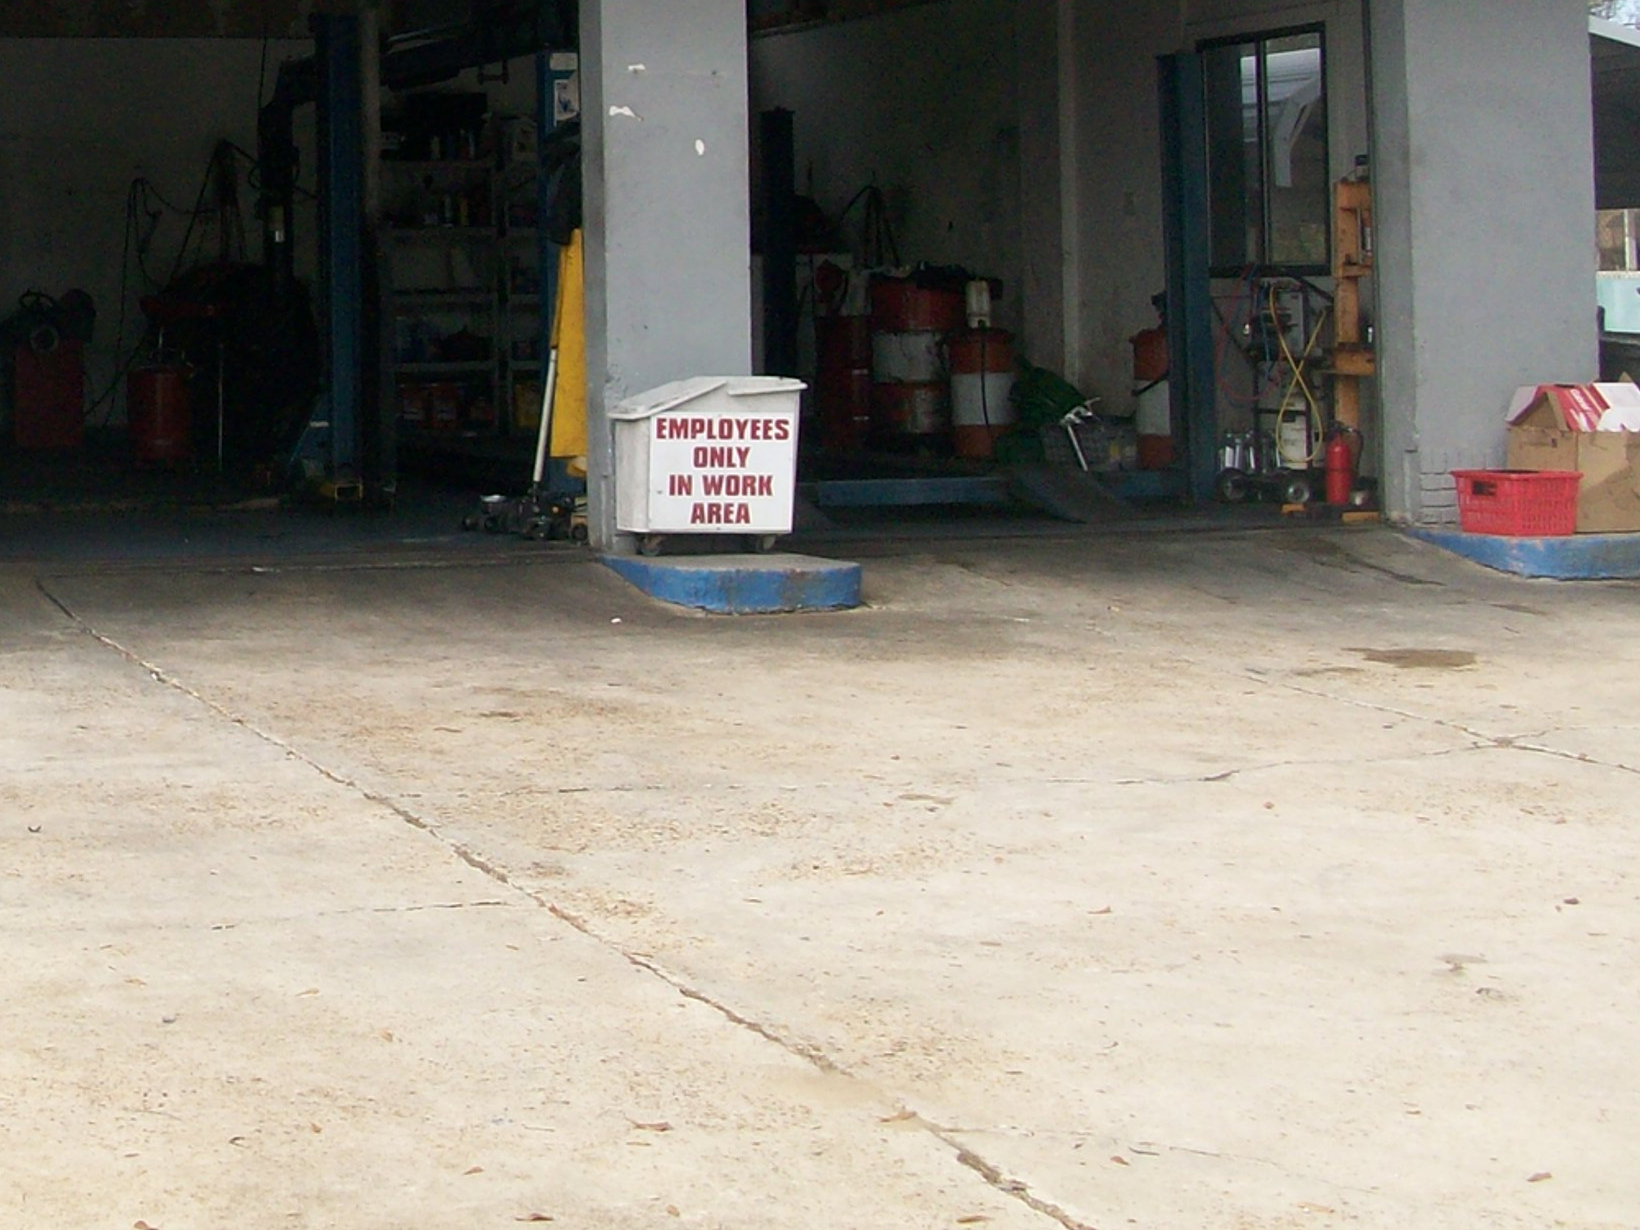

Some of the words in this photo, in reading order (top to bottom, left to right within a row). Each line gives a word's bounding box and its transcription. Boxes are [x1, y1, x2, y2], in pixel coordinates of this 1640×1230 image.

[655, 418, 790, 440] EMPLOYEES
[693, 446, 751, 468] ONLY
[668, 474, 693, 496] IN
[701, 474, 774, 496] WORK
[690, 502, 751, 524] AREA
